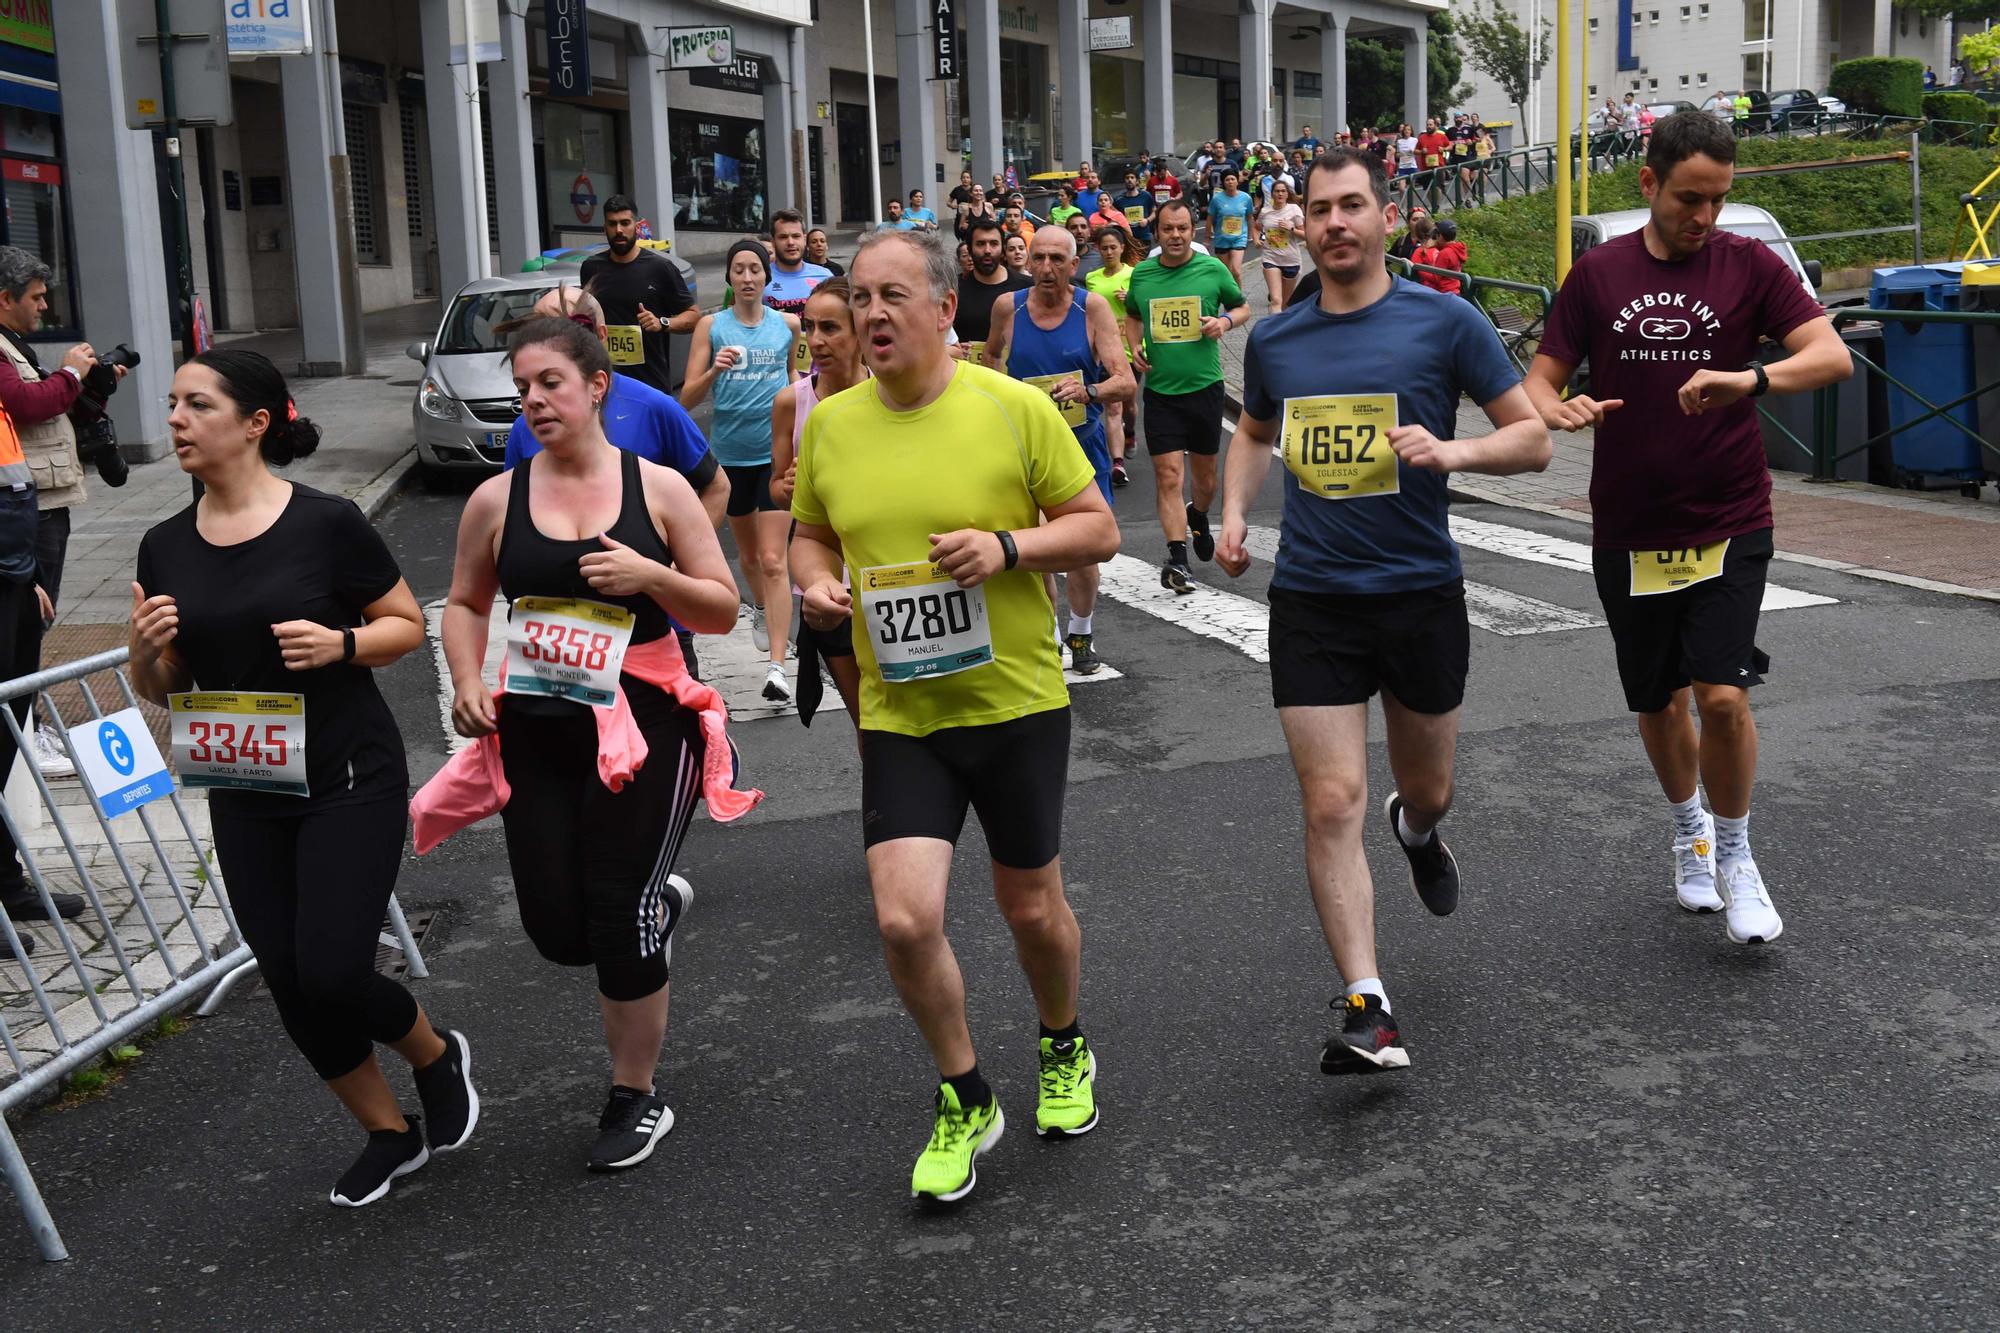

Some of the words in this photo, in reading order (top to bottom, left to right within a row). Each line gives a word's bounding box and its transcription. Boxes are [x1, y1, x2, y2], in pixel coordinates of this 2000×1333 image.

[671, 29, 729, 63] FRUTERIA
[699, 123, 720, 137] MALER
[1161, 309, 1190, 328] 468
[1612, 292, 1687, 333] REEBOK
[1690, 300, 1721, 337] INT.
[607, 336, 635, 353] 1645
[750, 348, 776, 357] TRAIL
[751, 357, 776, 365] IBIZA
[1620, 350, 1712, 361] ATHLETICS
[1301, 424, 1376, 465] 1652
[1317, 468, 1359, 478] IGLESIAS
[1664, 566, 1697, 575] ALBERTO
[875, 590, 972, 644] 3280
[522, 621, 612, 671] 3358
[908, 644, 944, 656] MANUEL
[534, 665, 551, 675] LORE
[556, 670, 591, 681] MONTERO
[914, 663, 937, 673] 22.05
[189, 722, 287, 766] 3345
[208, 766, 238, 775] LUCIA
[243, 768, 273, 777] FARTO
[122, 783, 152, 804] DEPORTES
